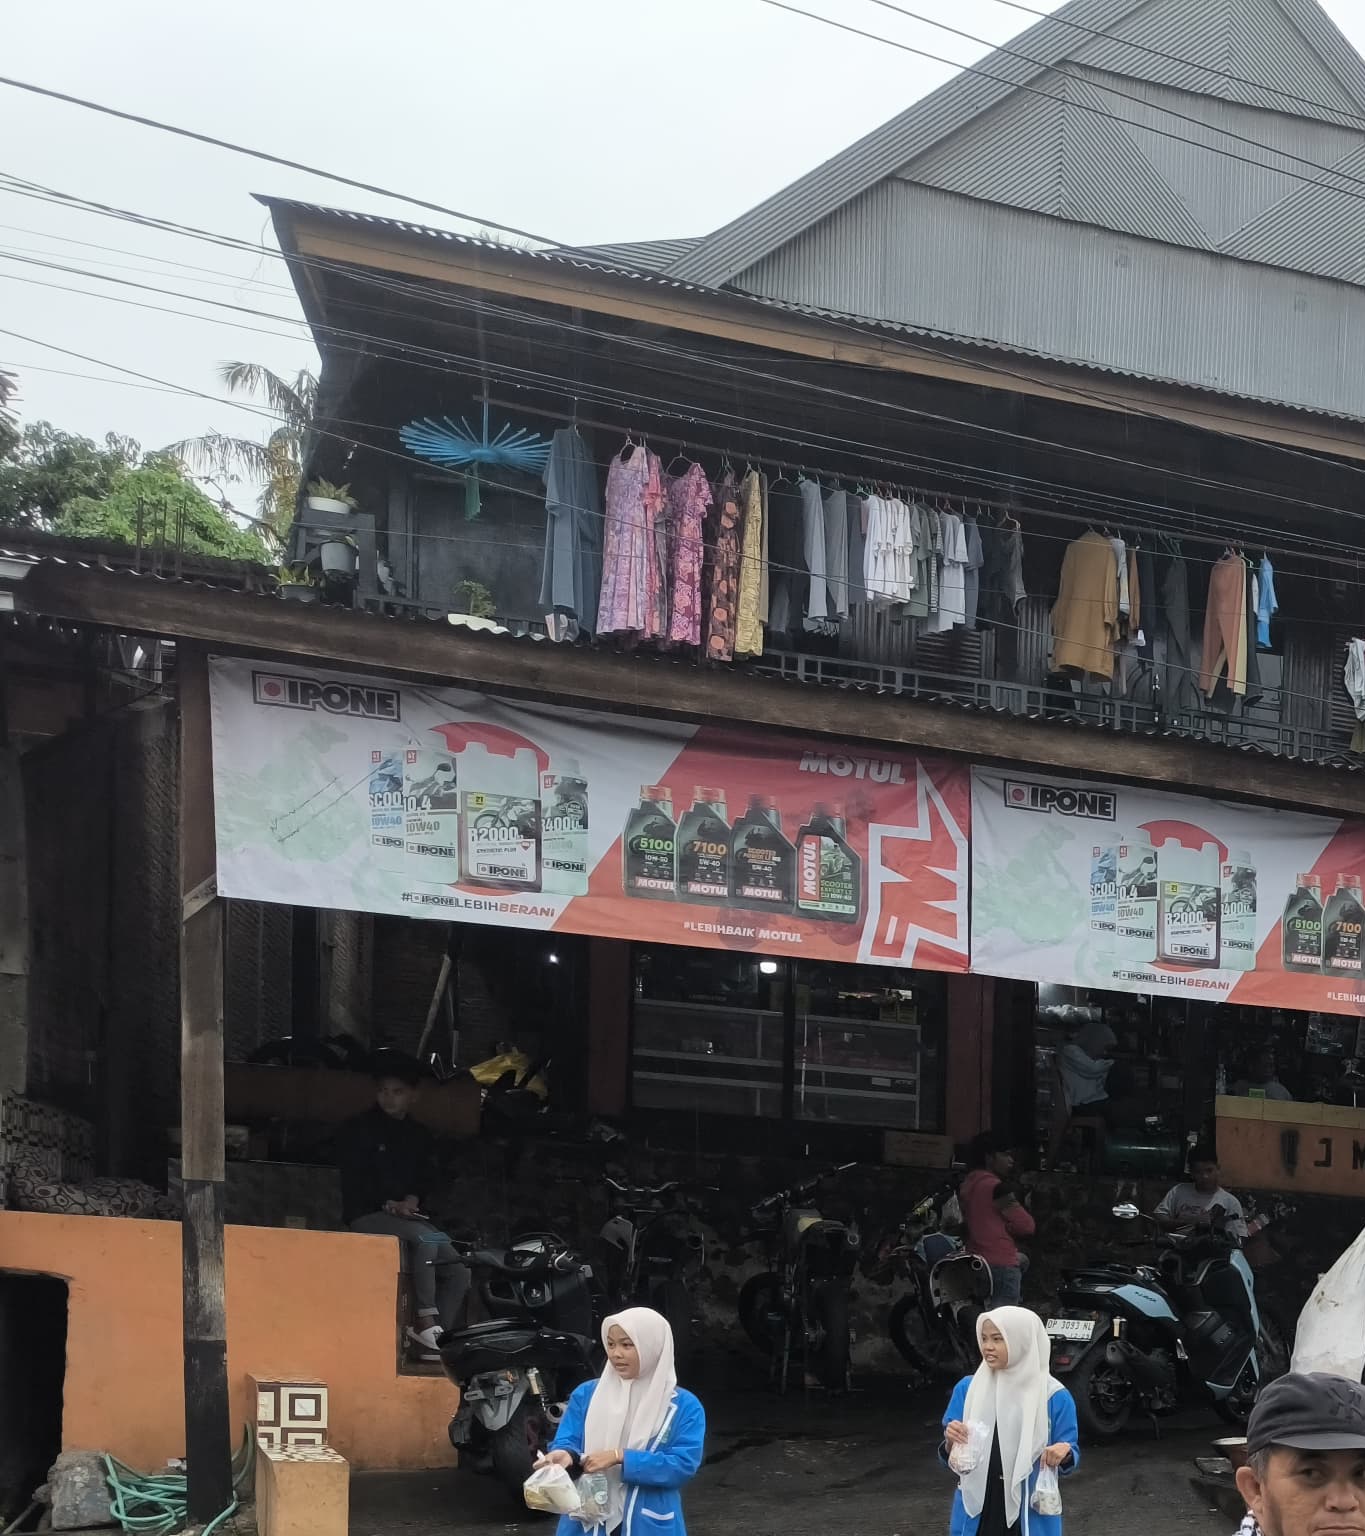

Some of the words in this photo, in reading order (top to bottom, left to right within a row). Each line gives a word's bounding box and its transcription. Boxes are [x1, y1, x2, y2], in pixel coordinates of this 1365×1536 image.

[286, 679, 398, 719] IPONE
[800, 751, 906, 785] MOTUL
[1030, 787, 1112, 817] IPONE
[639, 837, 673, 852] 5100
[693, 840, 727, 855] 7100
[488, 866, 526, 879] IPONE
[551, 860, 585, 873] IPONE
[804, 841, 817, 896] MOTUL
[743, 886, 782, 901] MOTUL
[684, 921, 755, 938] #LEBIHBAIK
[758, 928, 803, 943] MOTUL
[1295, 919, 1321, 931] 5100
[1336, 921, 1361, 933] 7100
[1180, 946, 1209, 956] IPONE
